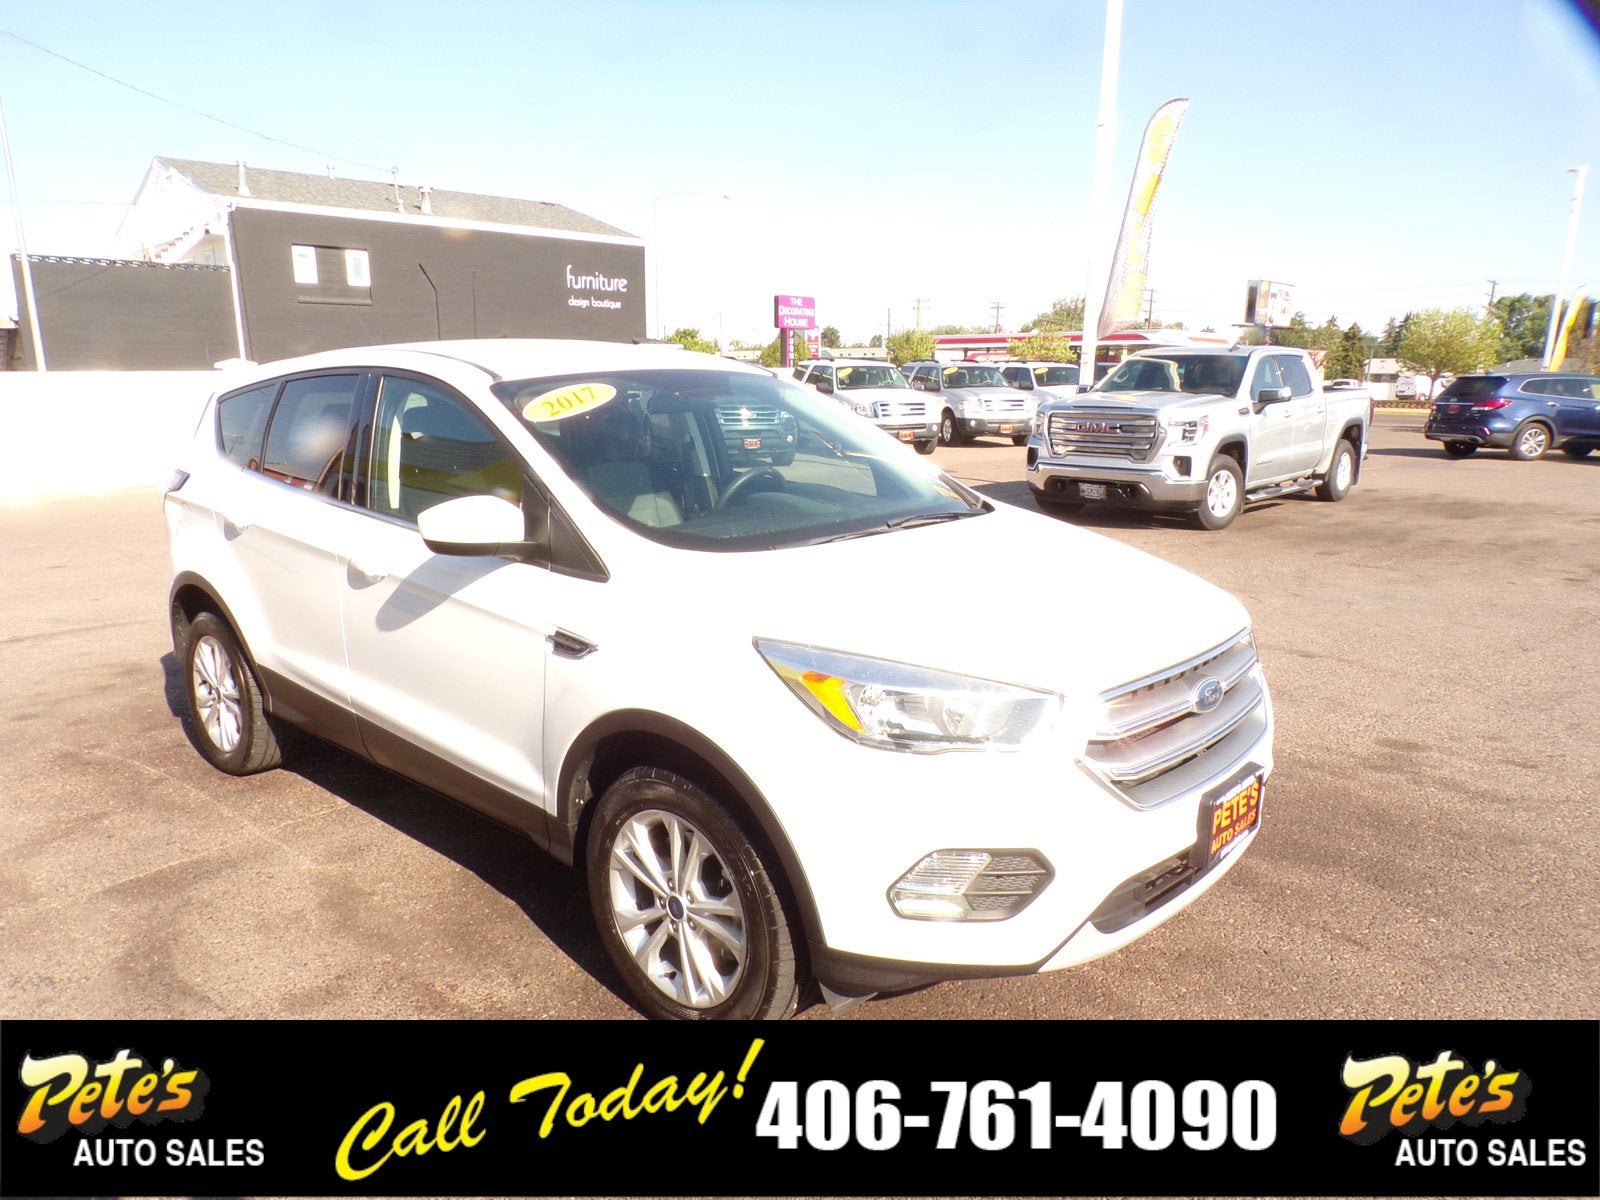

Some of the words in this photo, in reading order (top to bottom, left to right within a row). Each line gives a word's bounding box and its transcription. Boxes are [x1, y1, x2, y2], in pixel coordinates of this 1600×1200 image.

[566, 264, 628, 292] furniture
[568, 295, 590, 308] design
[591, 296, 622, 309] boutique
[790, 297, 803, 306] THE
[784, 316, 809, 327] HOUSE
[541, 386, 596, 416] 2017
[1212, 780, 1260, 835] PETE'S
[1210, 827, 1235, 855] AUTO
[1234, 808, 1257, 836] SALES
